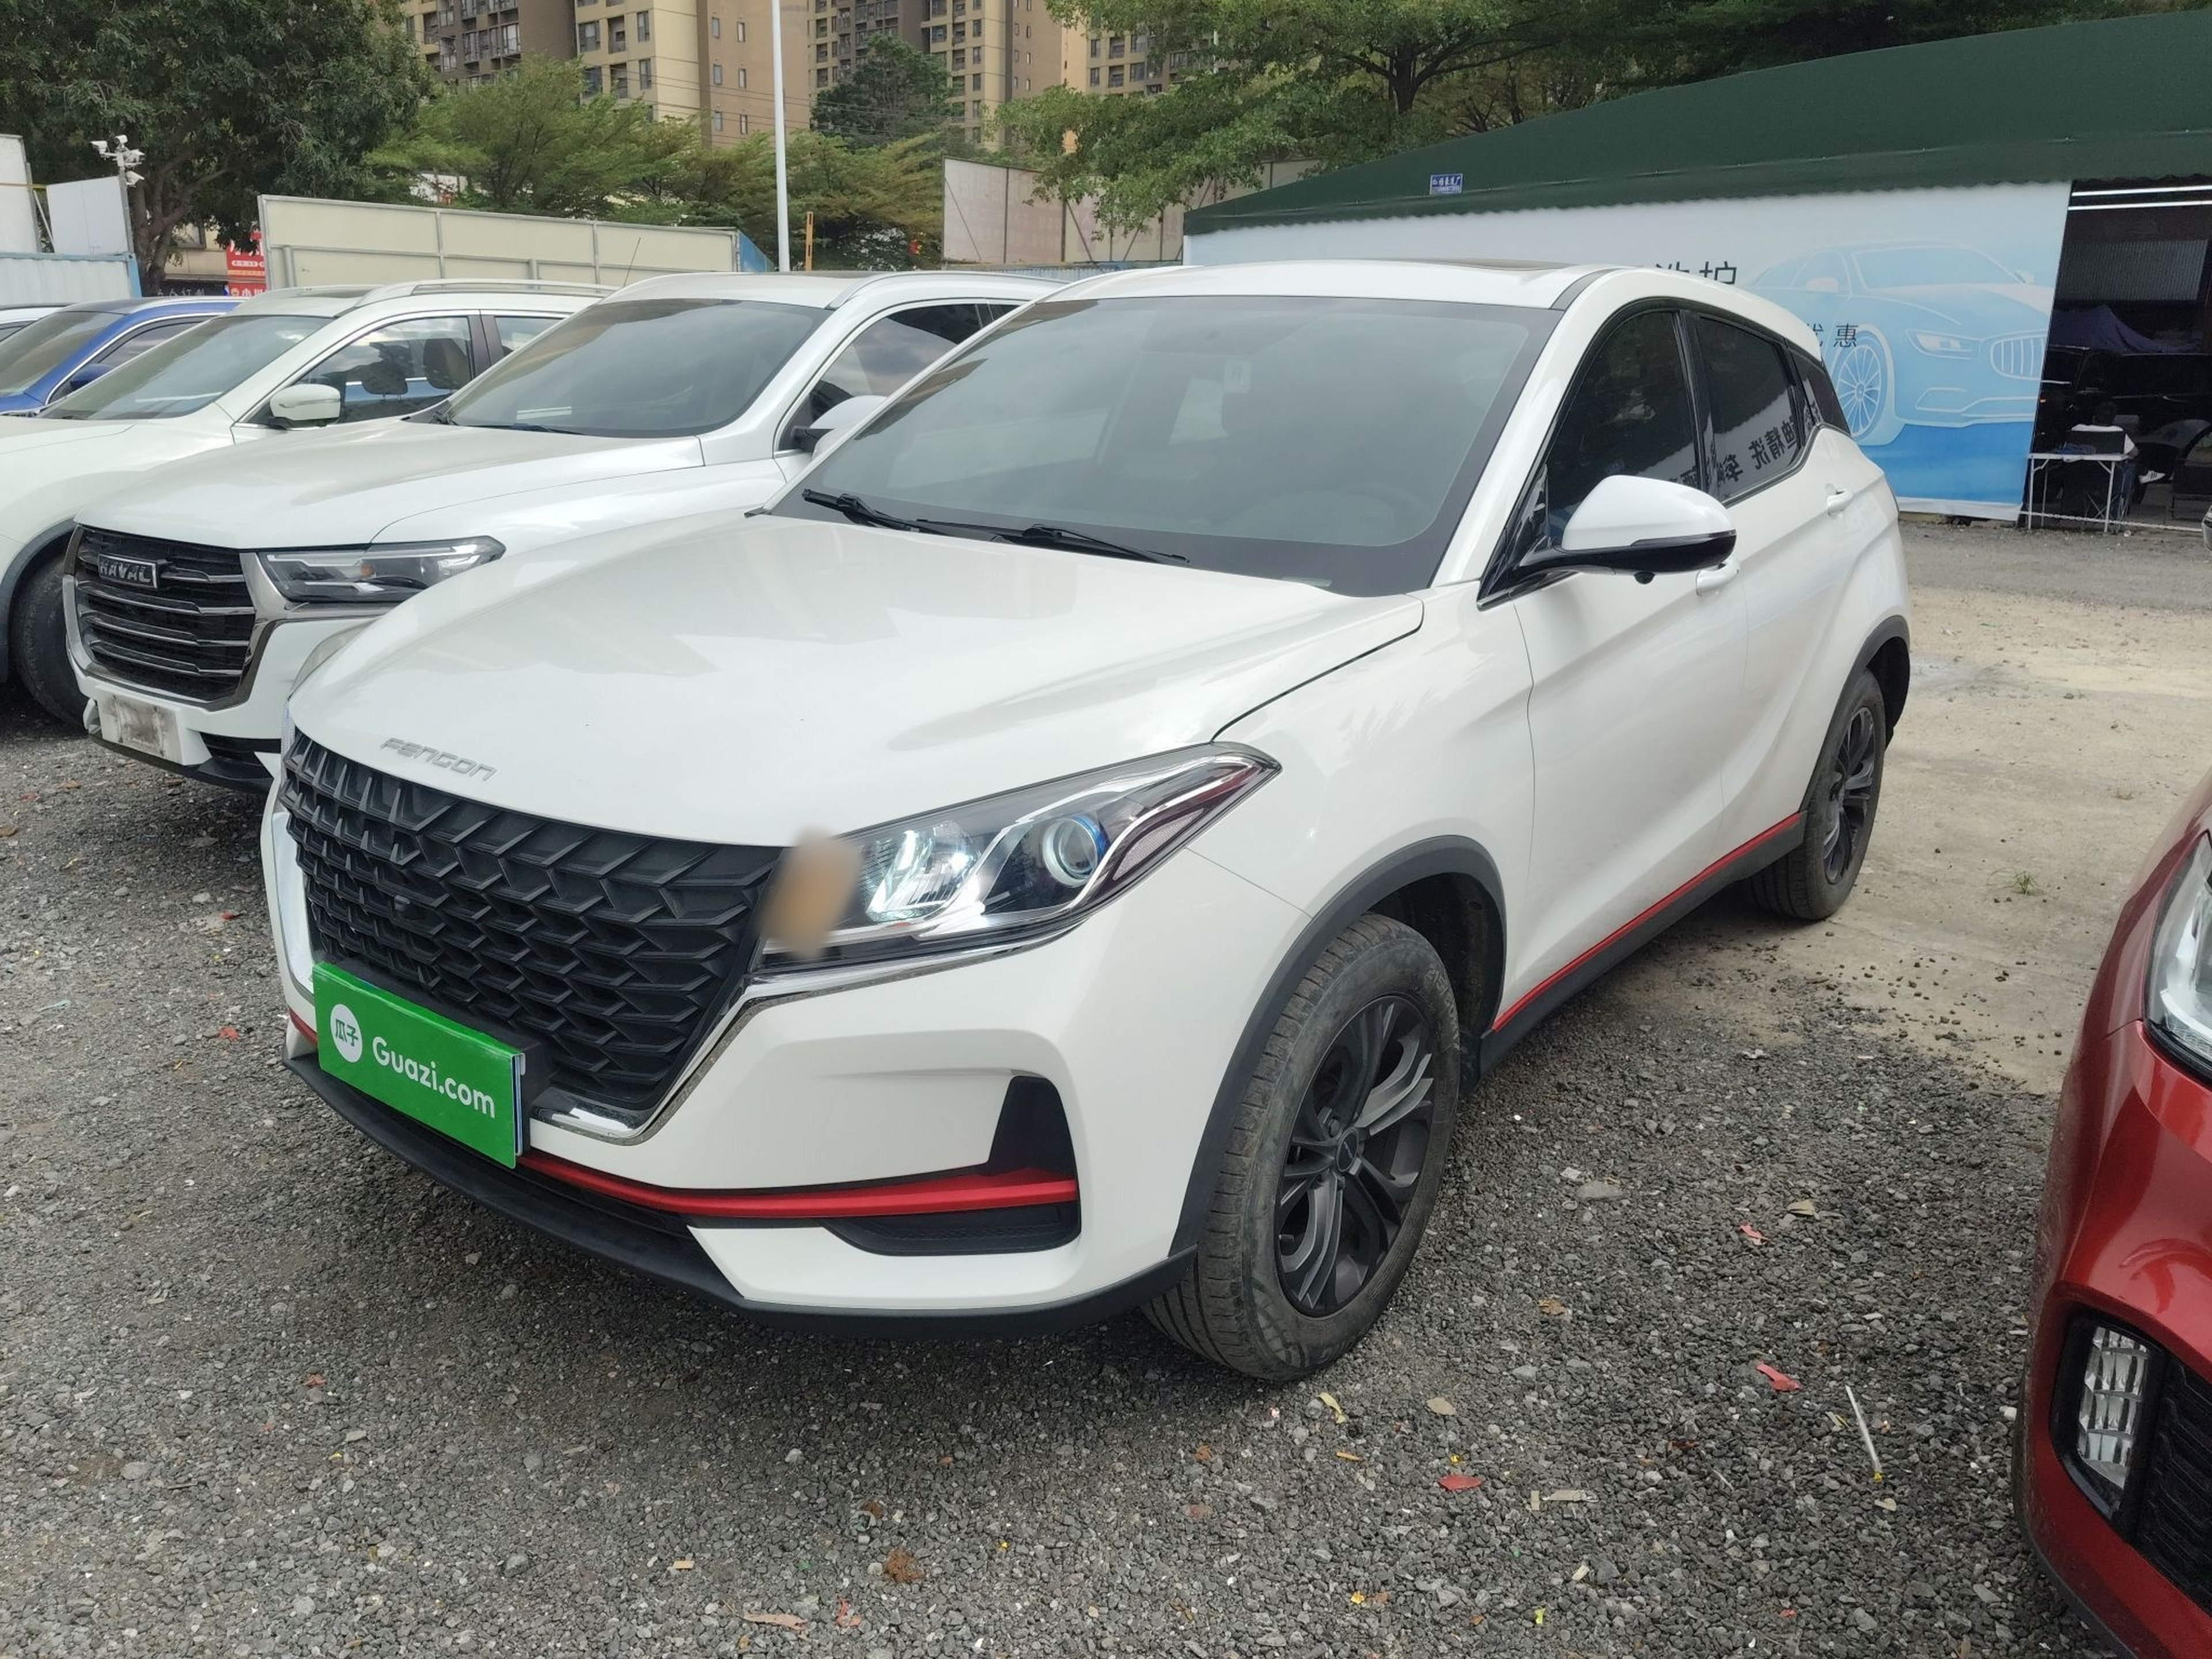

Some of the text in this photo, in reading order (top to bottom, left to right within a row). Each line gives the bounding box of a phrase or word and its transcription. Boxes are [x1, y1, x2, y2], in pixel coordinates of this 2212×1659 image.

[100, 558, 151, 583] HAVAL
[335, 1018, 358, 1047] 瓜子
[372, 1036, 495, 1118] Guazi.com
